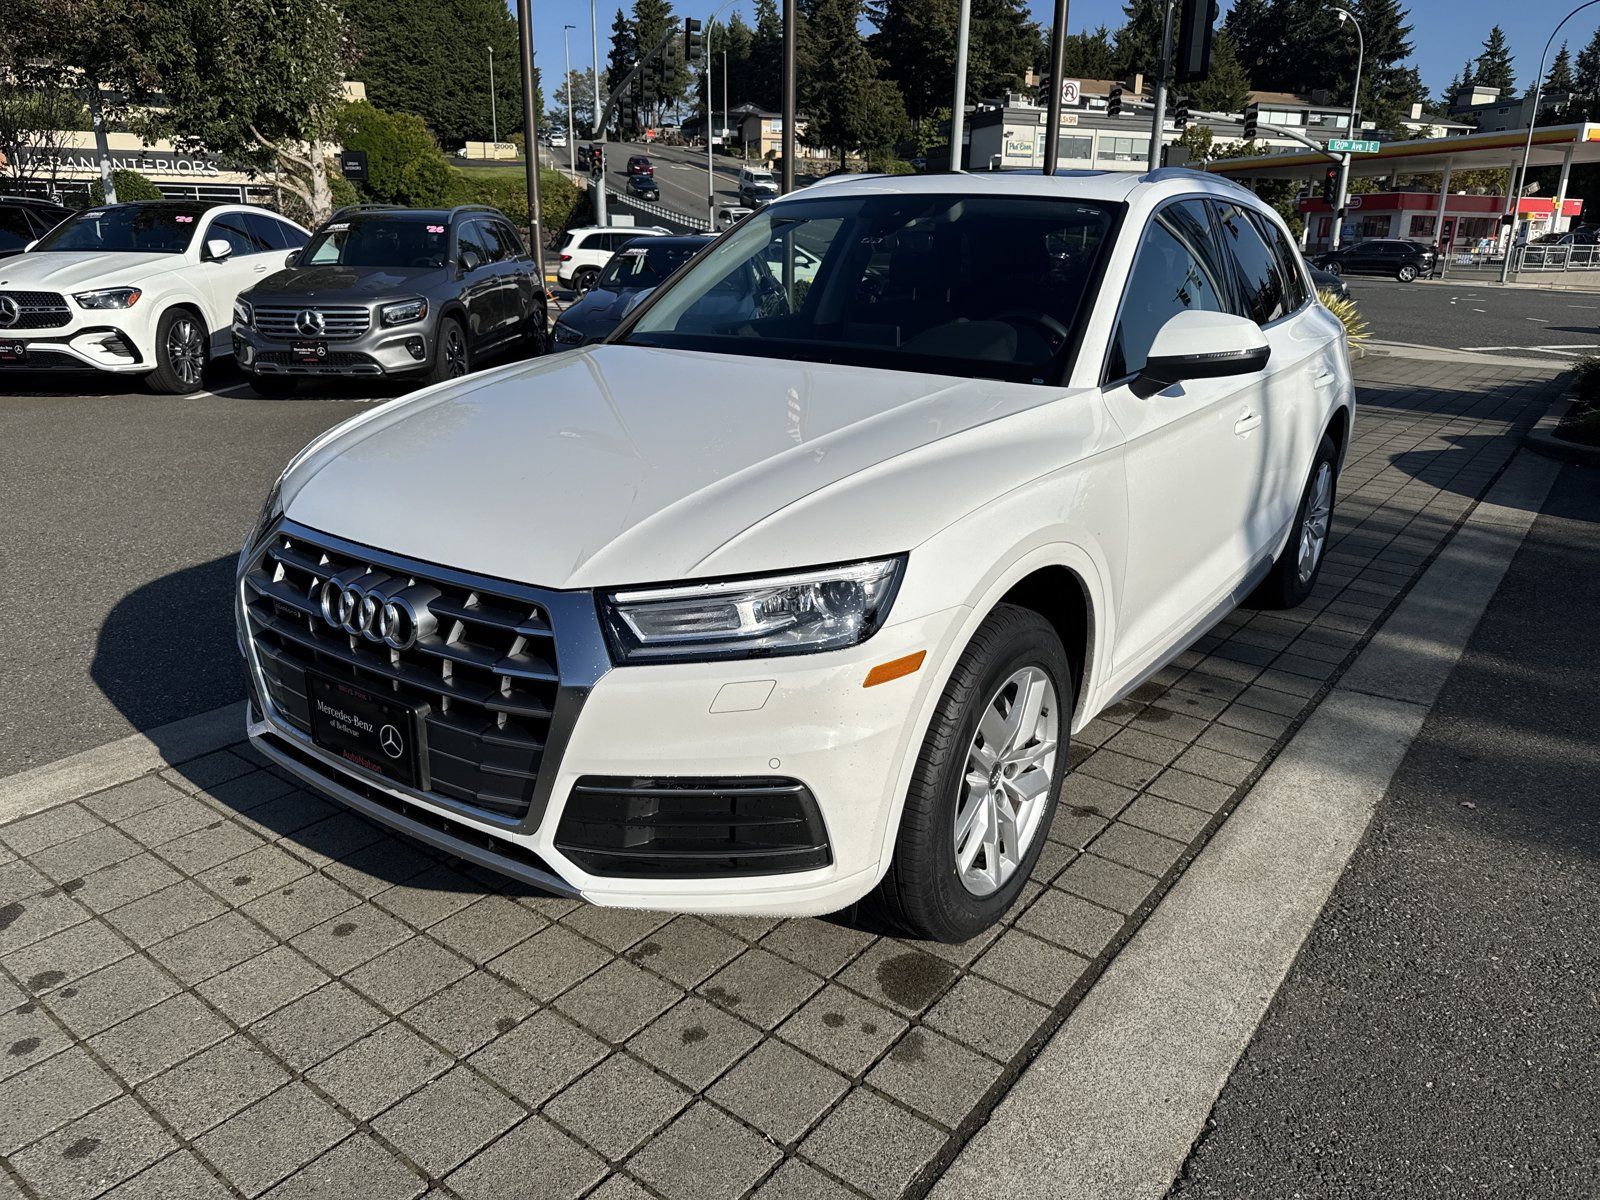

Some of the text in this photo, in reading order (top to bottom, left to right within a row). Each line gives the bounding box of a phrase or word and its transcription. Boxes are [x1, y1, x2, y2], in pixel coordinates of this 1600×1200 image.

[1351, 142, 1363, 151] Ave
[110, 156, 220, 177] NTERIORS
[317, 699, 374, 733] Mercedes-Benz
[329, 719, 360, 738] of Bellevue
[342, 749, 382, 774] AutoNation
